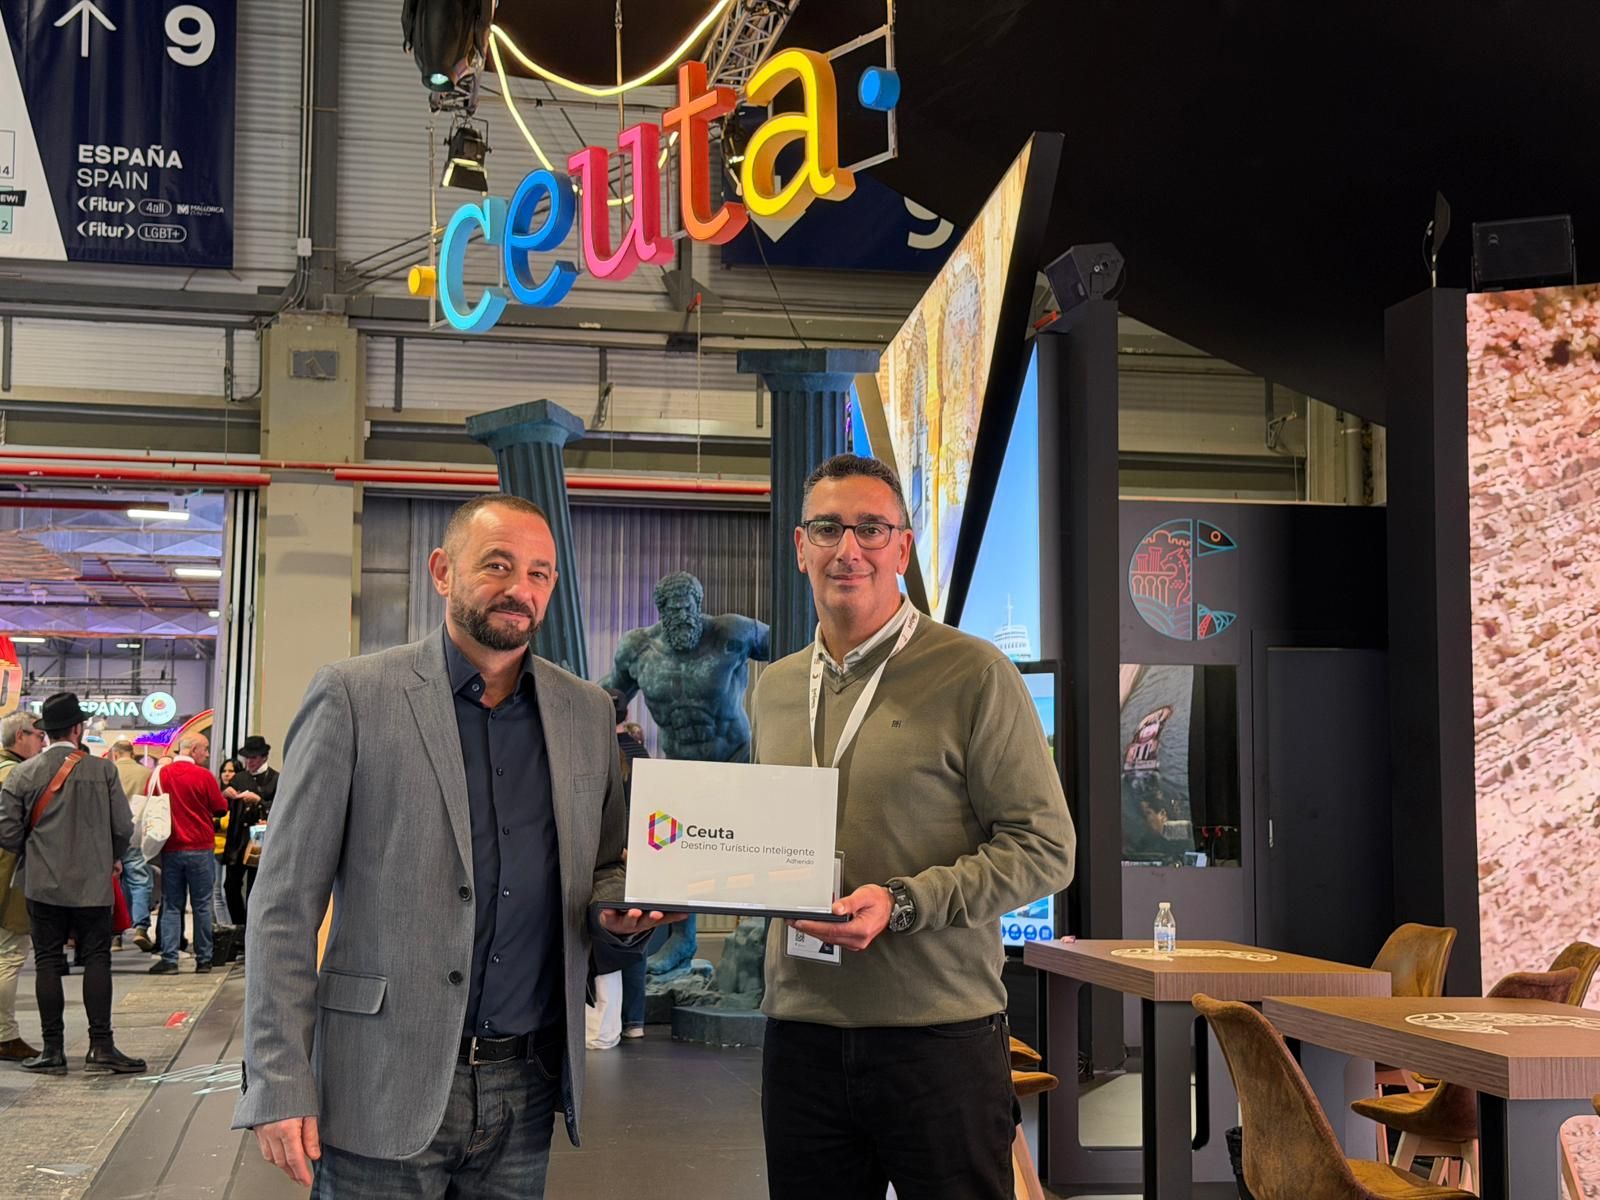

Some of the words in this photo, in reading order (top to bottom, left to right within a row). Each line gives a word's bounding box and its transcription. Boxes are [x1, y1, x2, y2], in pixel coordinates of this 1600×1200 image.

[164, 4, 216, 67] 9
[78, 144, 183, 169] ESPAÑA
[0, 165, 10, 176] 4
[77, 168, 149, 190] SPAIN
[438, 47, 856, 332] ceuta
[686, 825, 735, 840] Ceuta
[680, 840, 718, 851] Destino
[720, 842, 761, 854] Turístico
[762, 845, 816, 857] Inteligente
